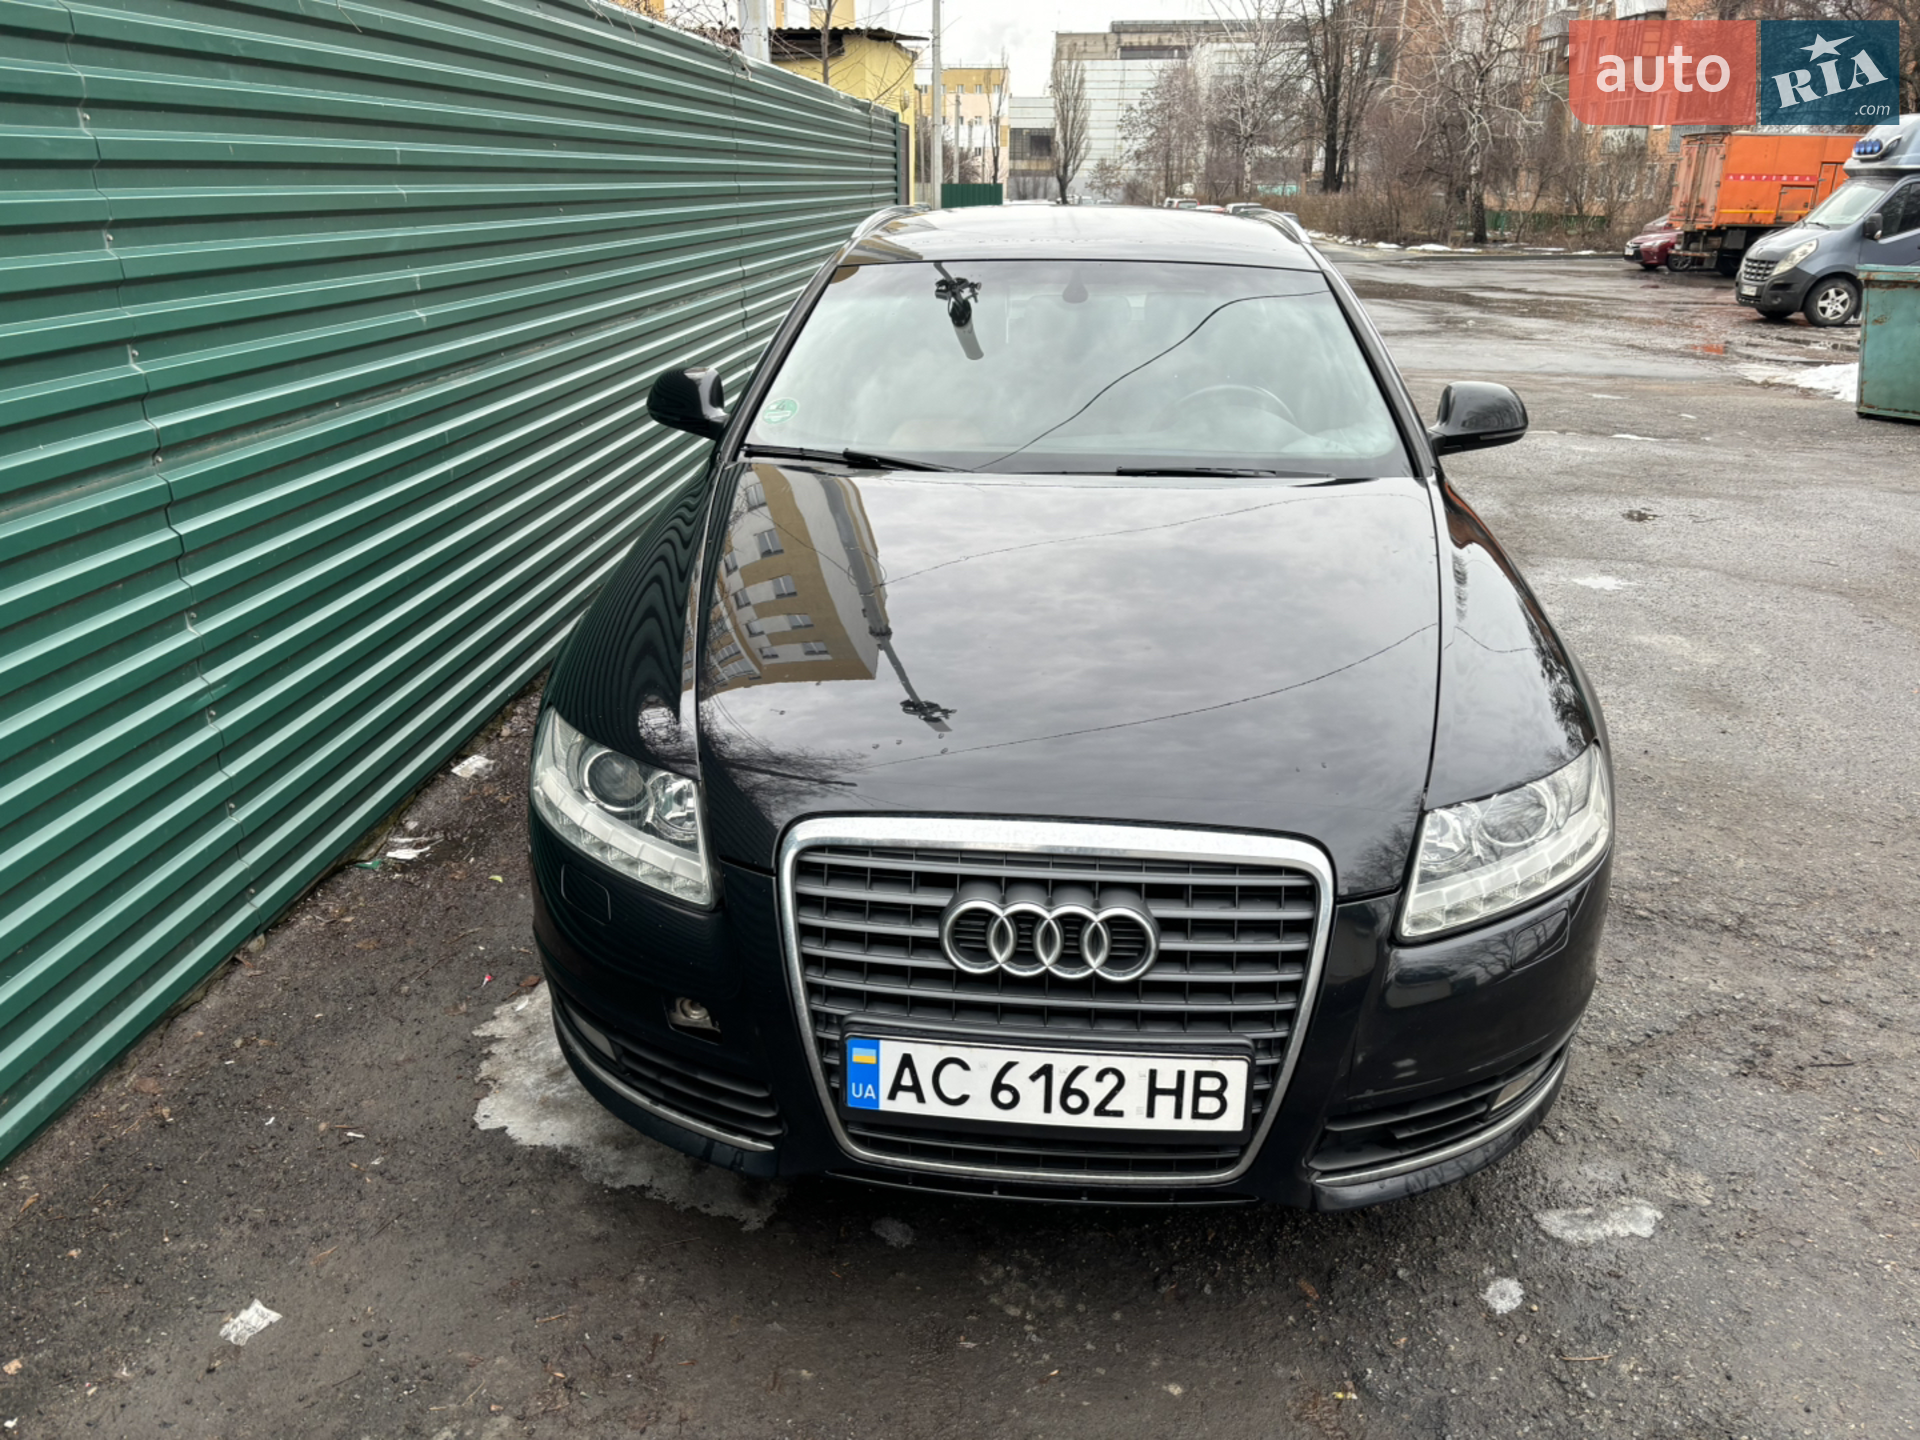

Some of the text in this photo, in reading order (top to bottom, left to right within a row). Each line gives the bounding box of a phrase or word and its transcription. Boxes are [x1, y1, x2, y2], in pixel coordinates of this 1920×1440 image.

[851, 1082, 877, 1100] UA
[887, 1053, 1228, 1120] AC 6162 HB
